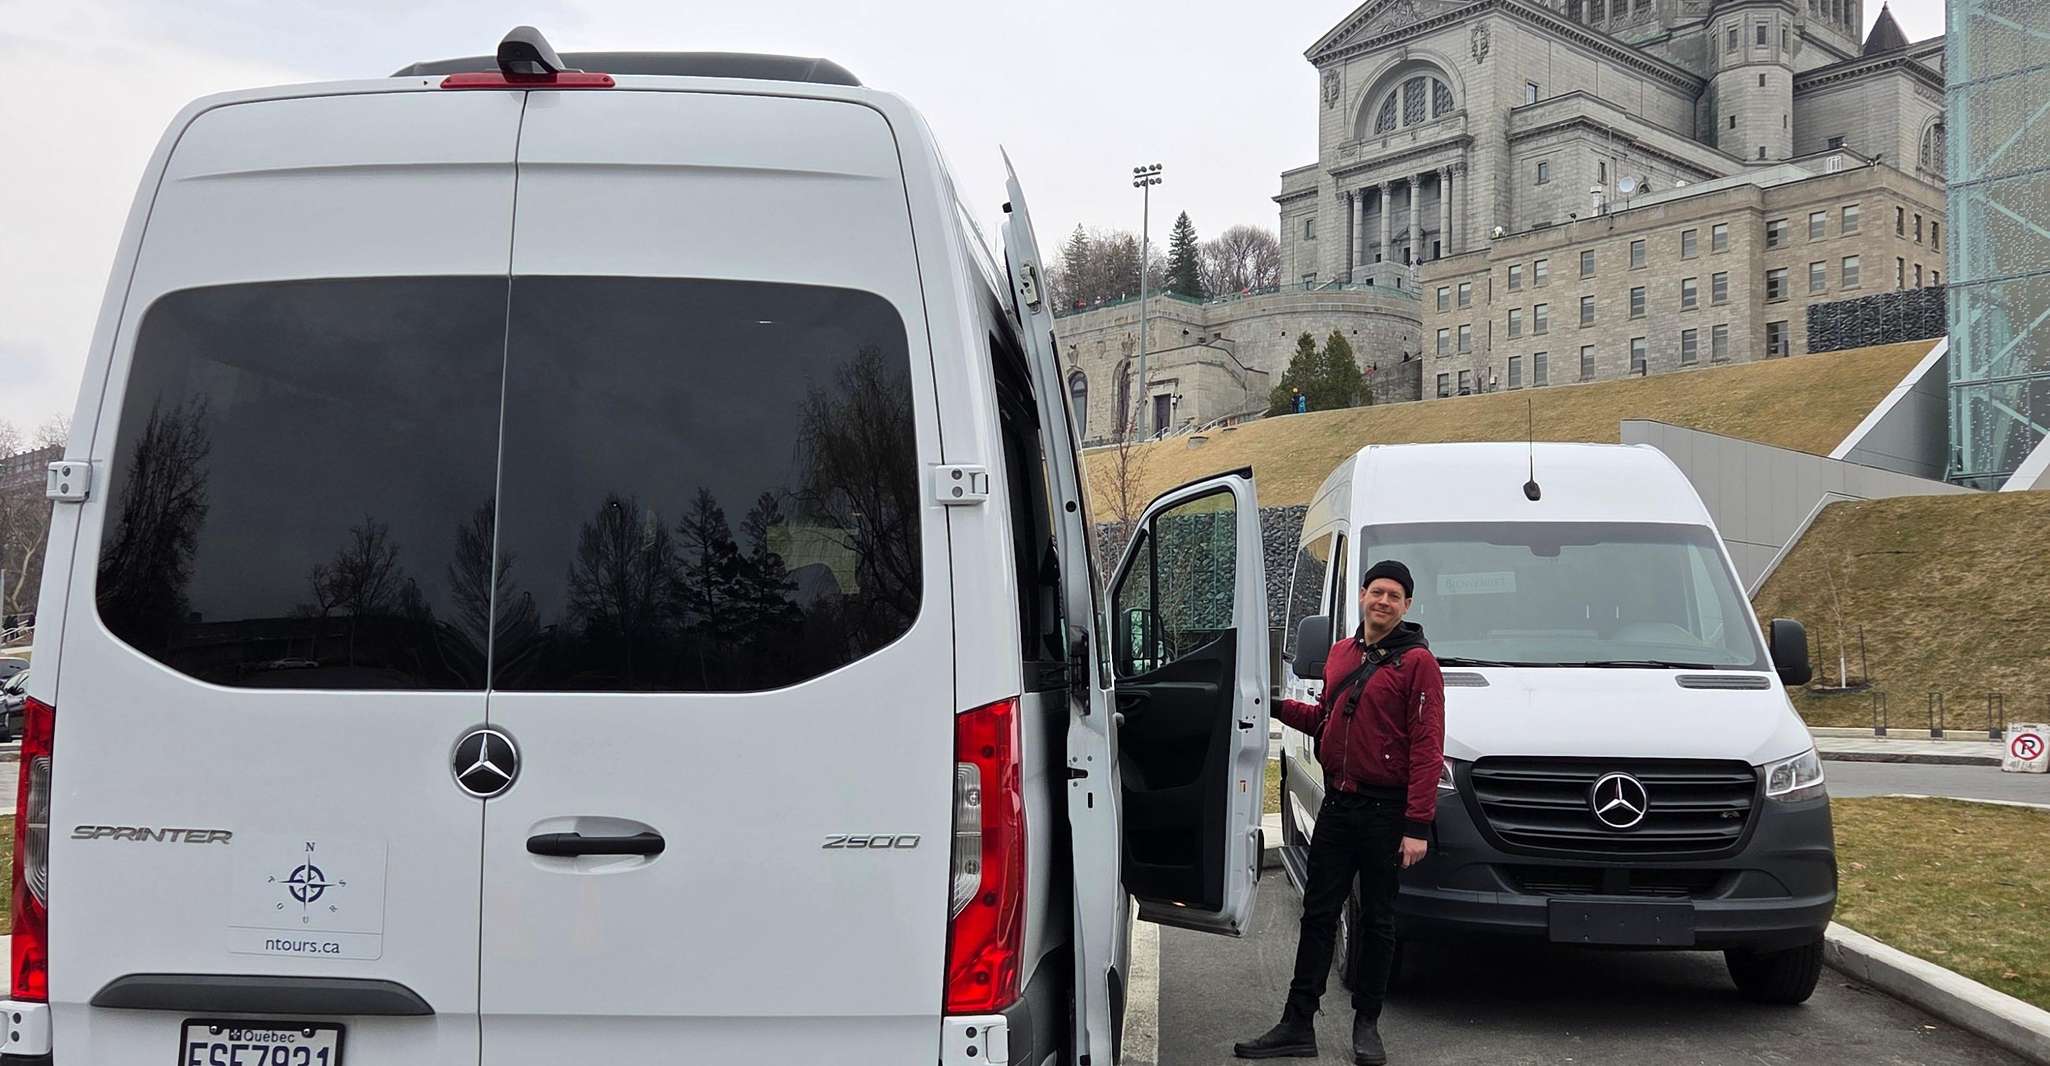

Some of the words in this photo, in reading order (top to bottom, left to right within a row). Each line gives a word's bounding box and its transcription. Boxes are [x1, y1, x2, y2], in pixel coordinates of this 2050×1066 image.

[70, 825, 233, 845] SPRINTER
[822, 834, 920, 849] 2500
[305, 841, 315, 852] N
[265, 936, 340, 954] ntours.ca
